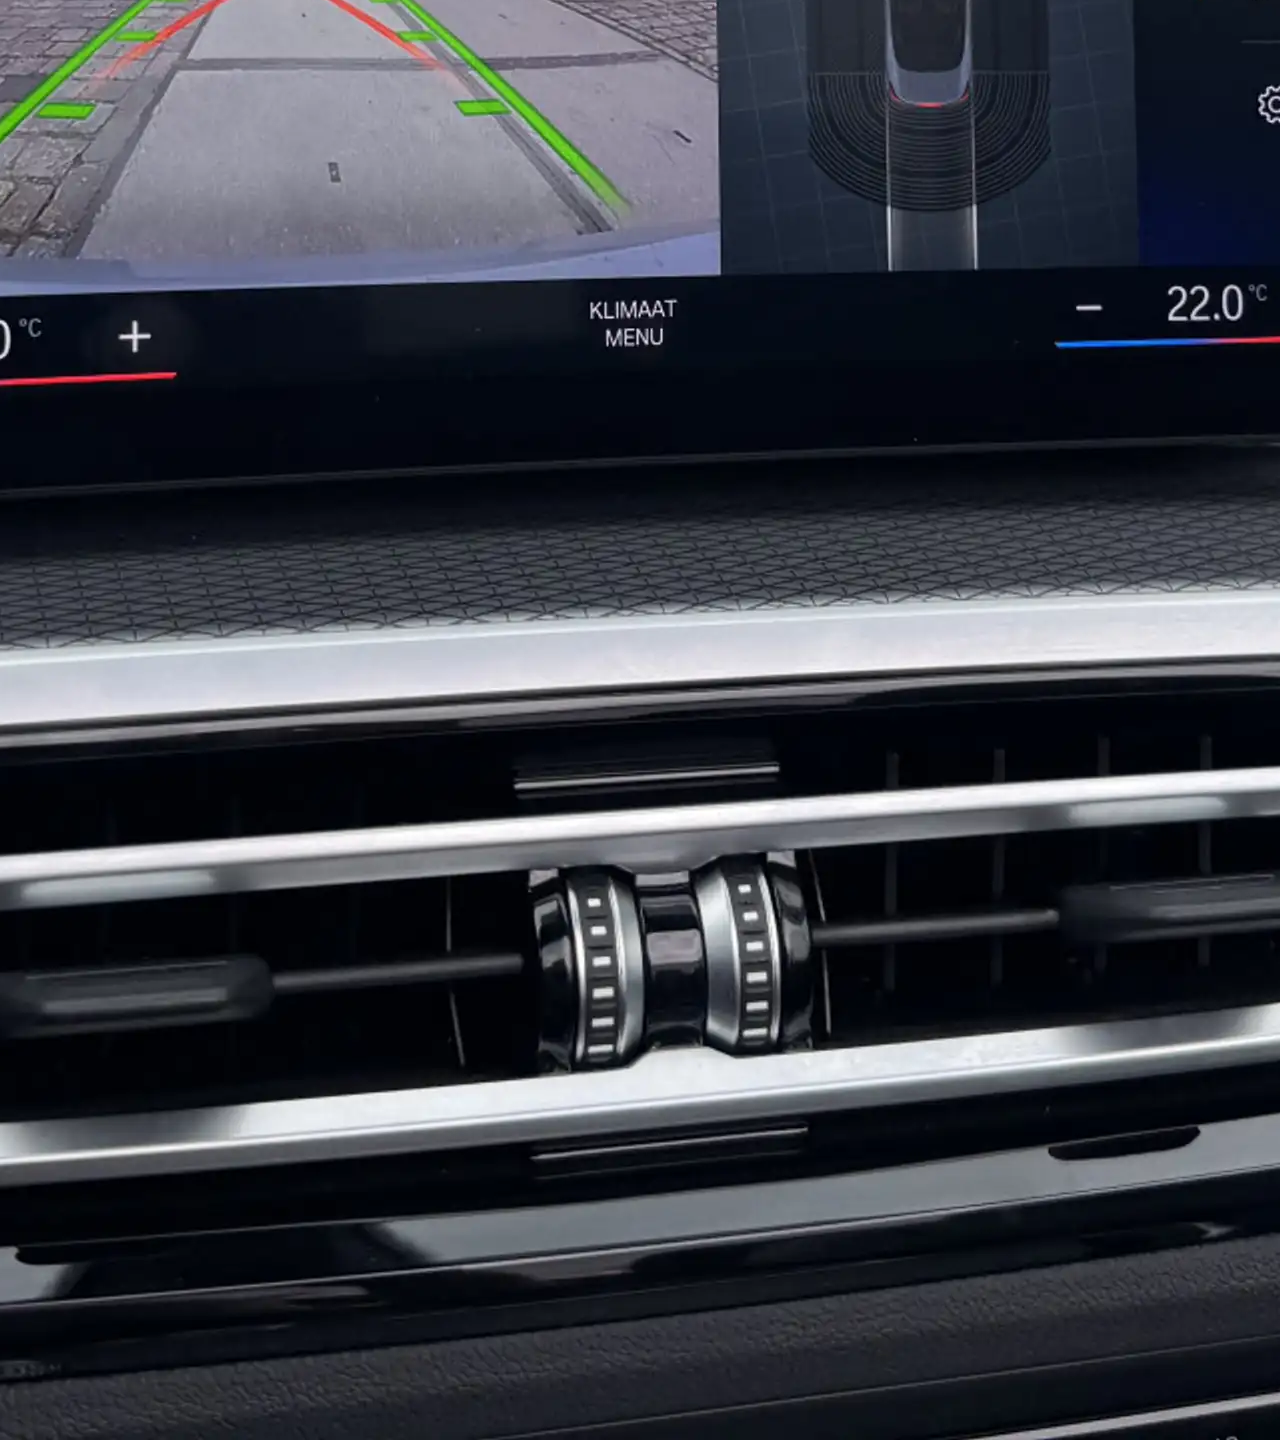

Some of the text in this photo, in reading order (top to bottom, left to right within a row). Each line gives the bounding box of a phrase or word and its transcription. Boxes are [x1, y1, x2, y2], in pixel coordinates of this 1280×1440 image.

[588, 298, 678, 321] KLIMAAT
[1167, 283, 1244, 322] 22.0
[604, 326, 664, 349] MENU
